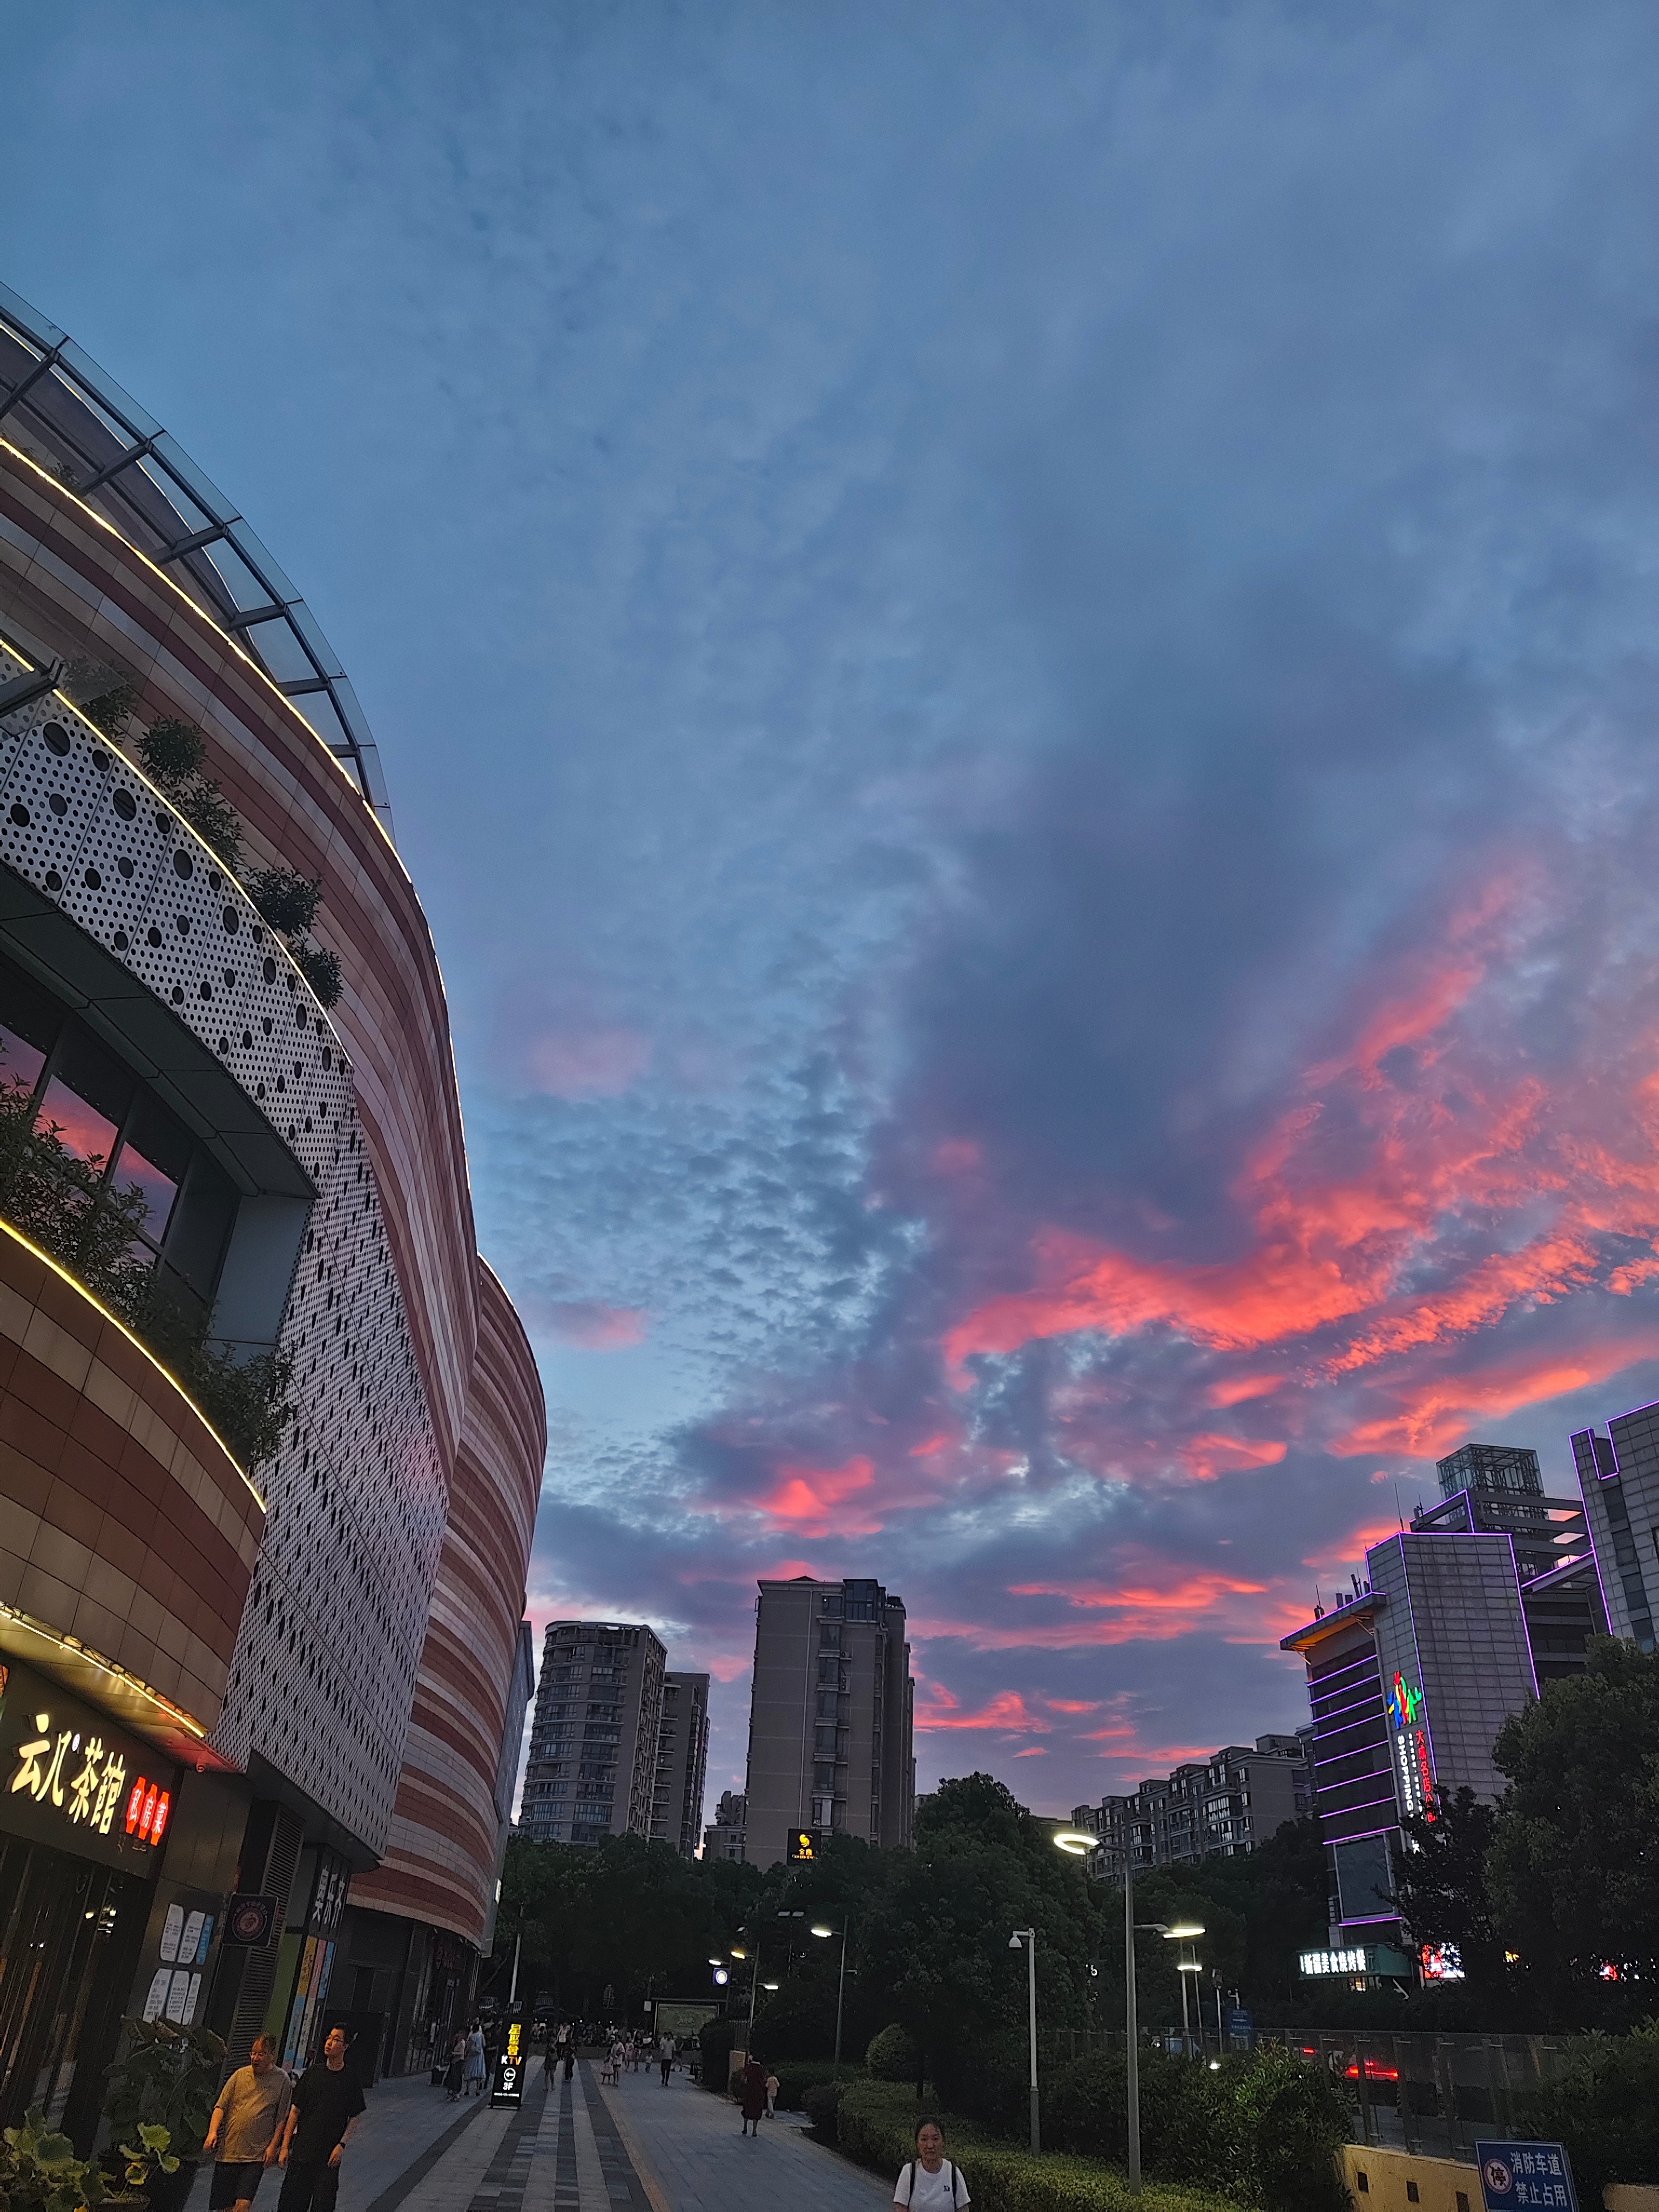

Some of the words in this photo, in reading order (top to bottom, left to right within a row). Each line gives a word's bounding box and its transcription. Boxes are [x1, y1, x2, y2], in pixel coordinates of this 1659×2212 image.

[1398, 1735, 1413, 1811] SHOPPING
[127, 1789, 167, 1835] 私房菜
[312, 1865, 346, 1928] 奥乐齐
[501, 2055, 522, 2065] KTV
[1491, 2167, 1506, 2186] 停
[1510, 2151, 1562, 2176] 消防车道
[1515, 2181, 1567, 2207] 禁止占用
